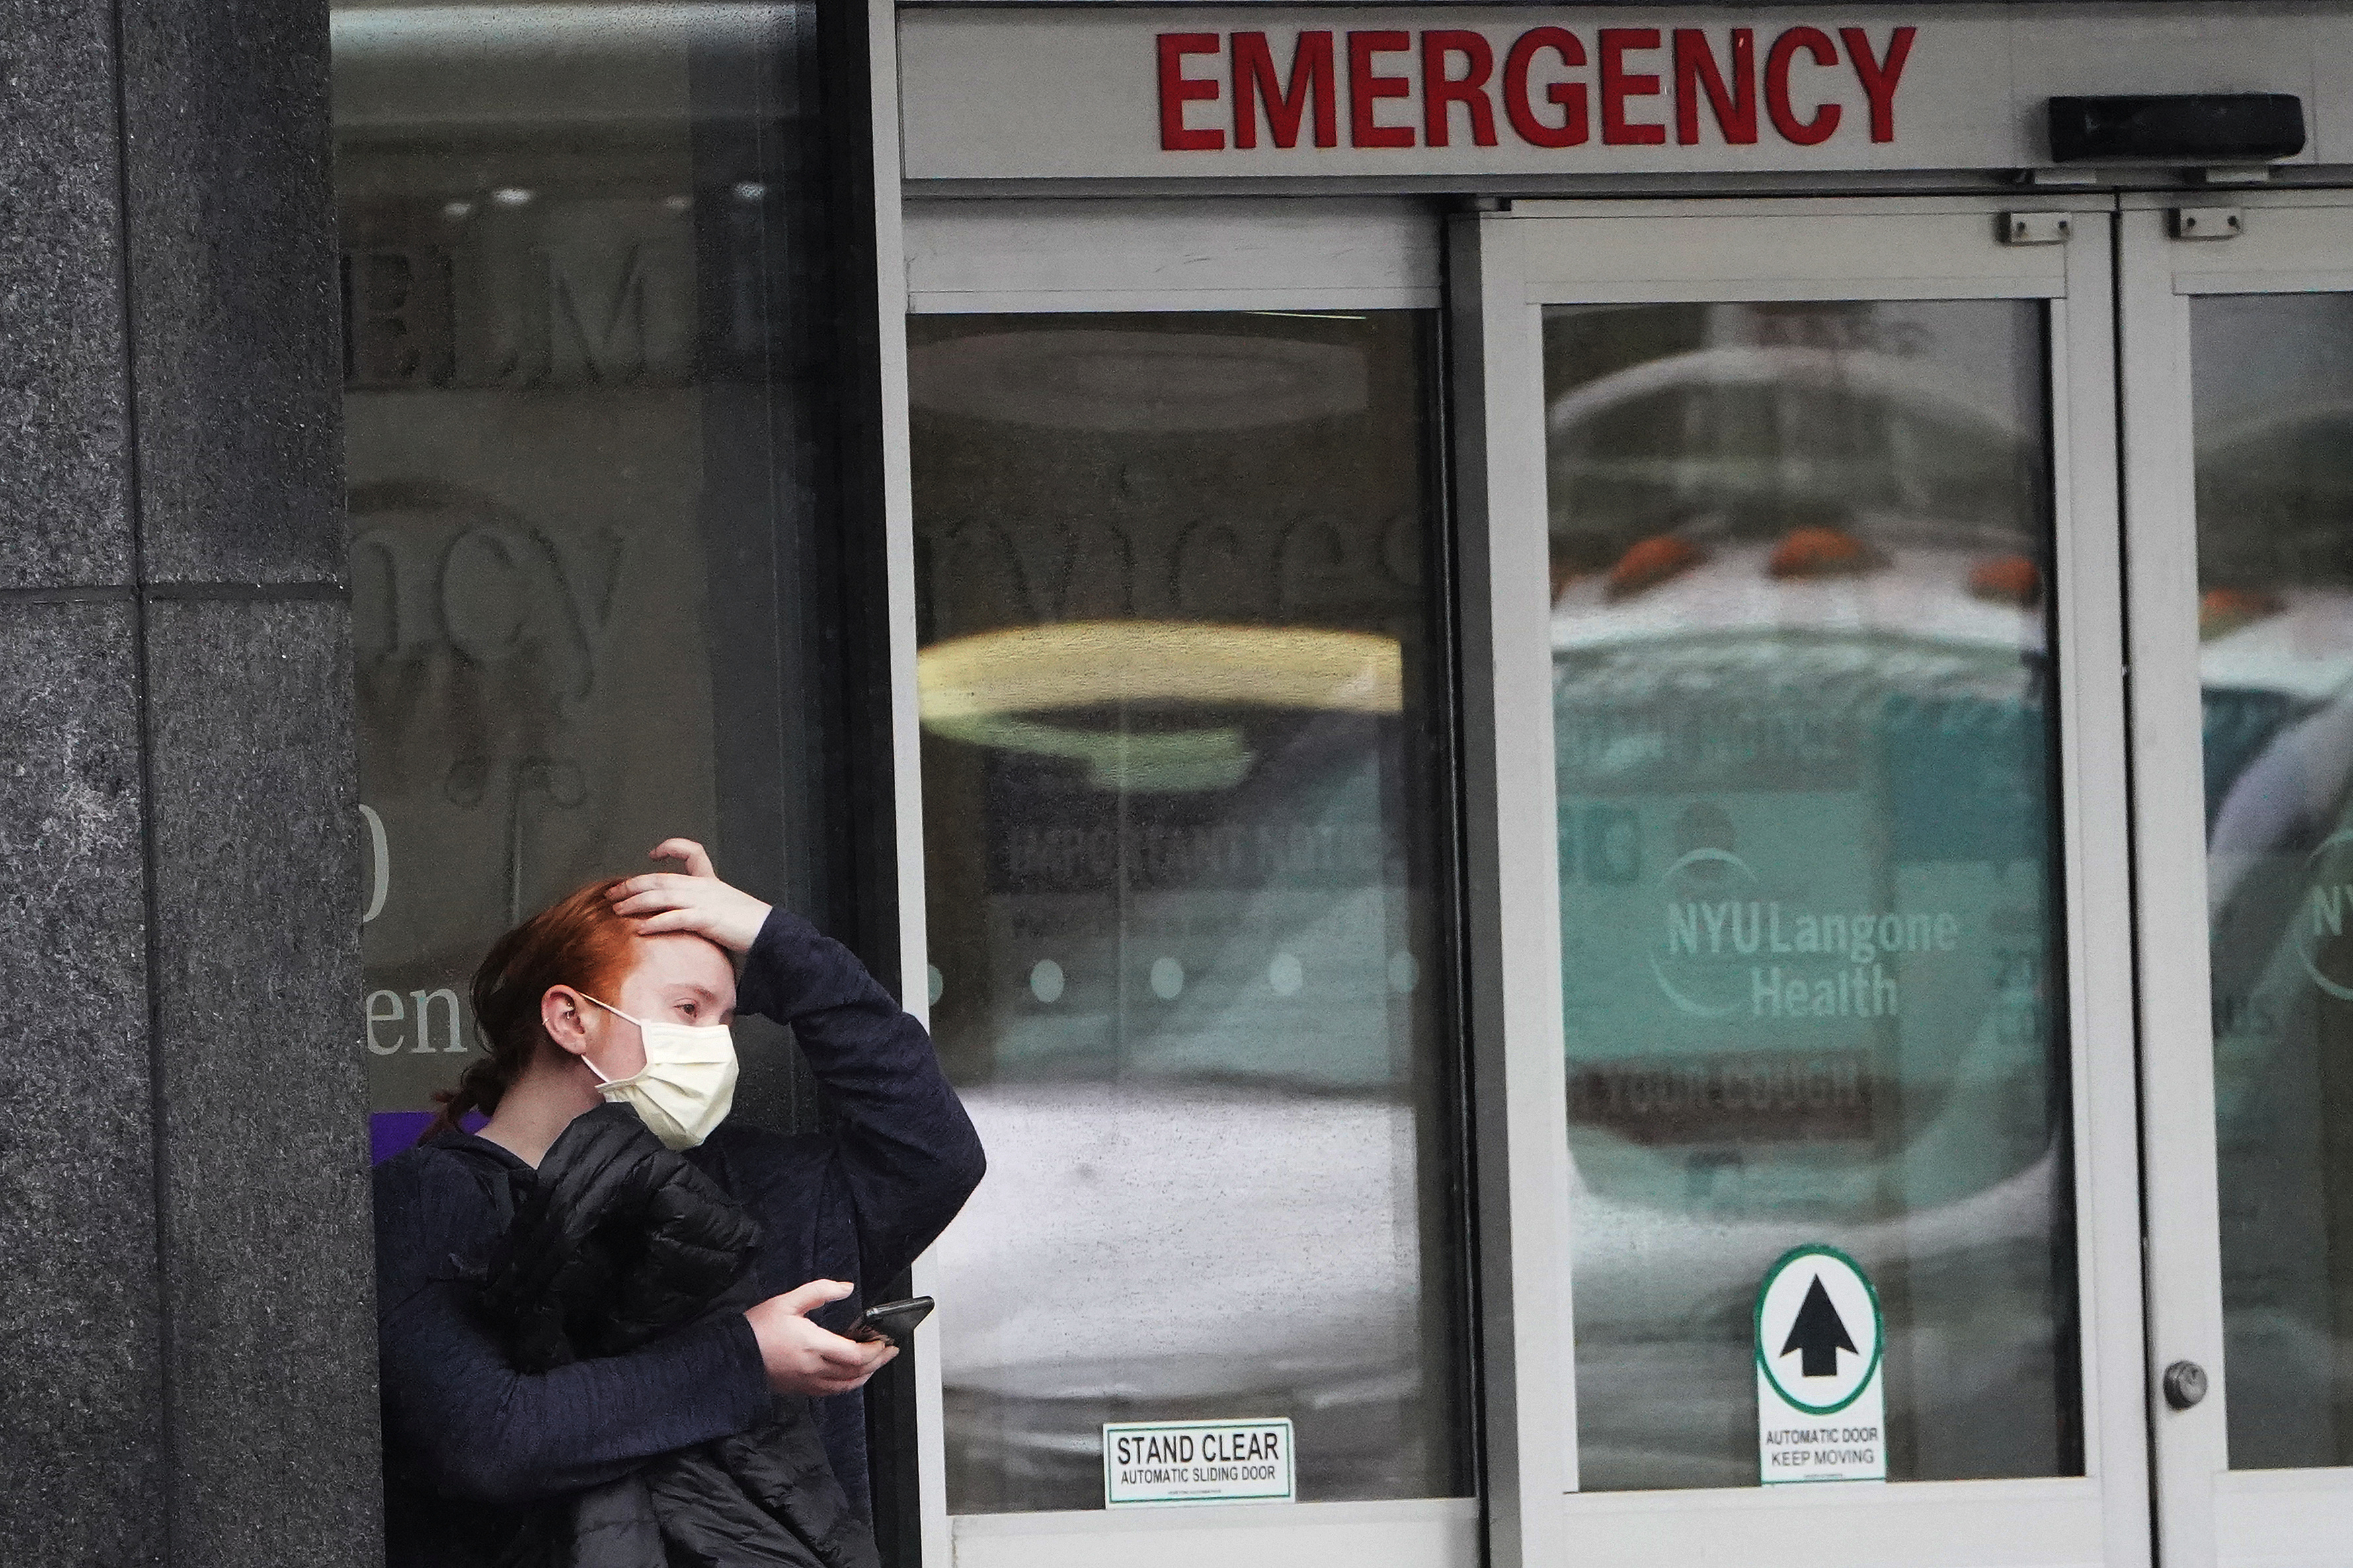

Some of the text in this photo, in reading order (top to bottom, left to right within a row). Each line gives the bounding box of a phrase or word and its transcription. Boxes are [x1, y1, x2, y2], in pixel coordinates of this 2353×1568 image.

[1156, 26, 1917, 151] EMERGENCY
[1666, 900, 1960, 964] NYU Langone
[1751, 964, 1900, 1018] Health
[1117, 1432, 1279, 1465] STAND CLEAR
[1766, 1427, 1878, 1446] AUTOMATIC DOOR
[1771, 1448, 1875, 1466] KEEP MOVING
[1121, 1465, 1276, 1485] AUTOMATIC SLIDING DOOR
